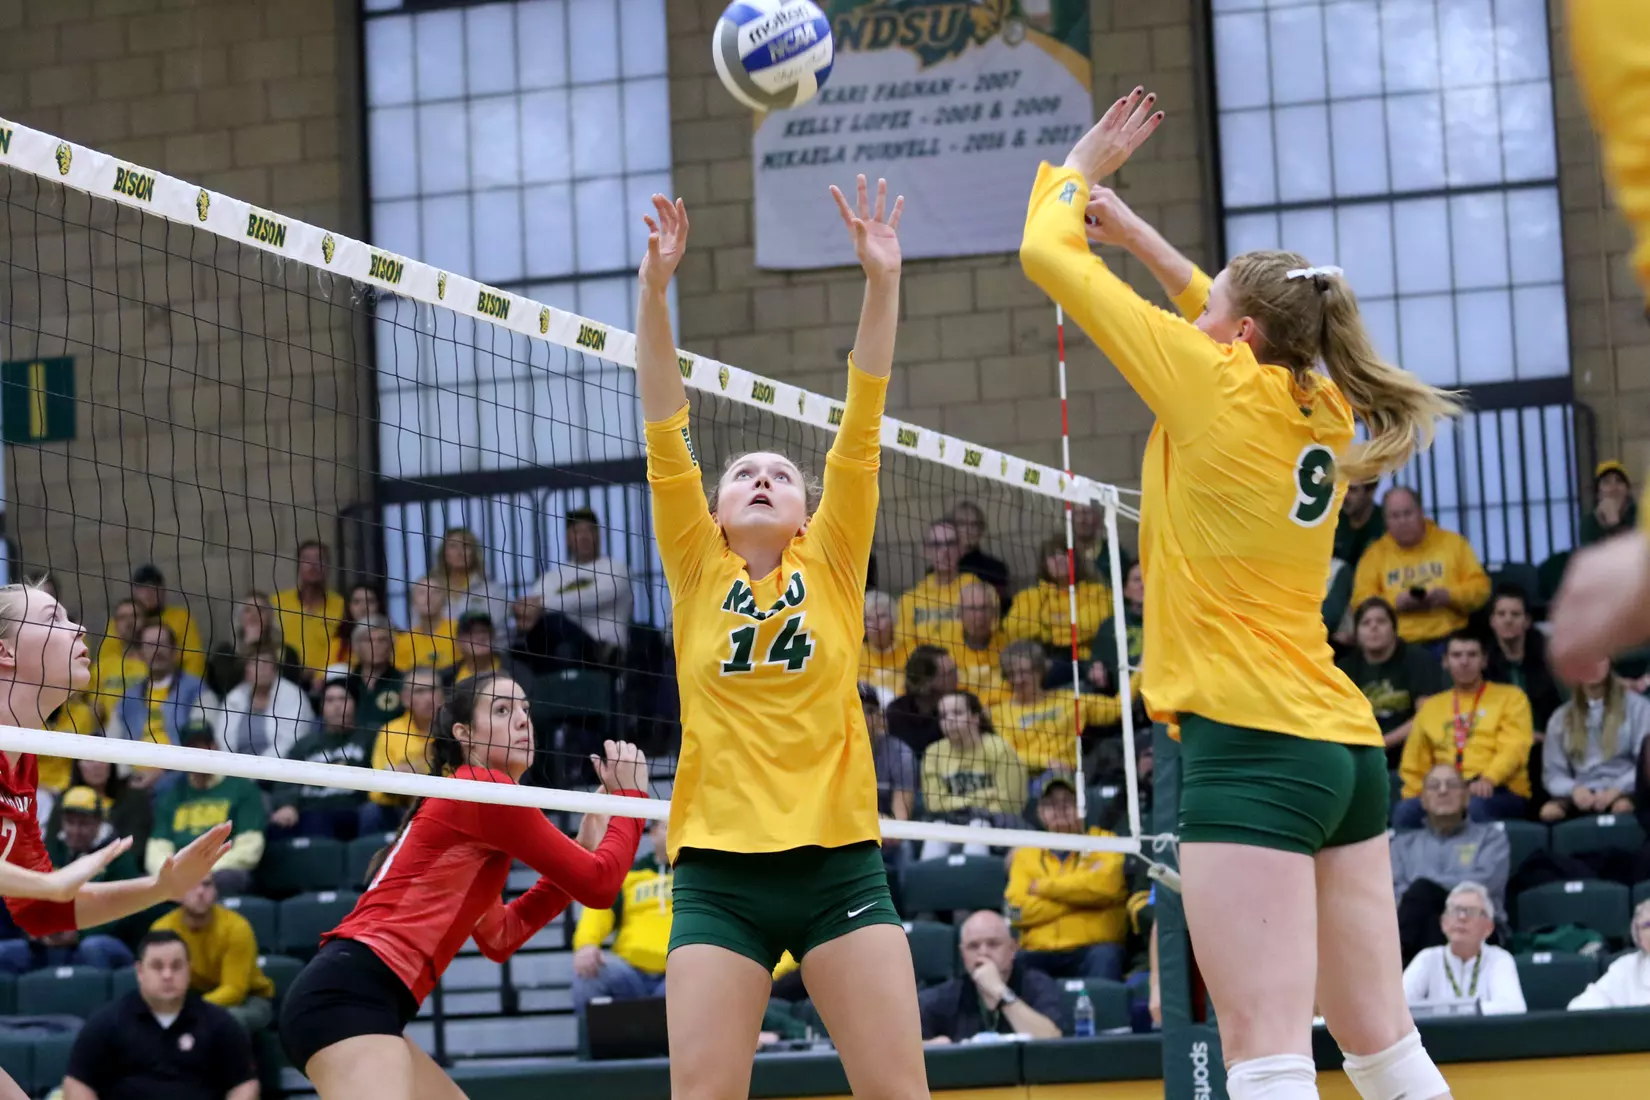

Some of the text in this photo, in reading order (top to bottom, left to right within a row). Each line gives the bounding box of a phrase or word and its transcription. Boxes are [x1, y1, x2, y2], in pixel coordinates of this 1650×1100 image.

[767, 22, 818, 62] NCAA
[834, 5, 967, 52] NDSU
[783, 116, 847, 138] KELLY
[849, 110, 913, 132] LOPEZ
[762, 145, 848, 172] MIKAELA
[112, 166, 155, 202] BISON
[246, 213, 287, 247] BISON
[369, 253, 404, 284] BISON
[477, 290, 511, 320] BISON
[1288, 443, 1336, 528] 9
[719, 610, 816, 676] 14
